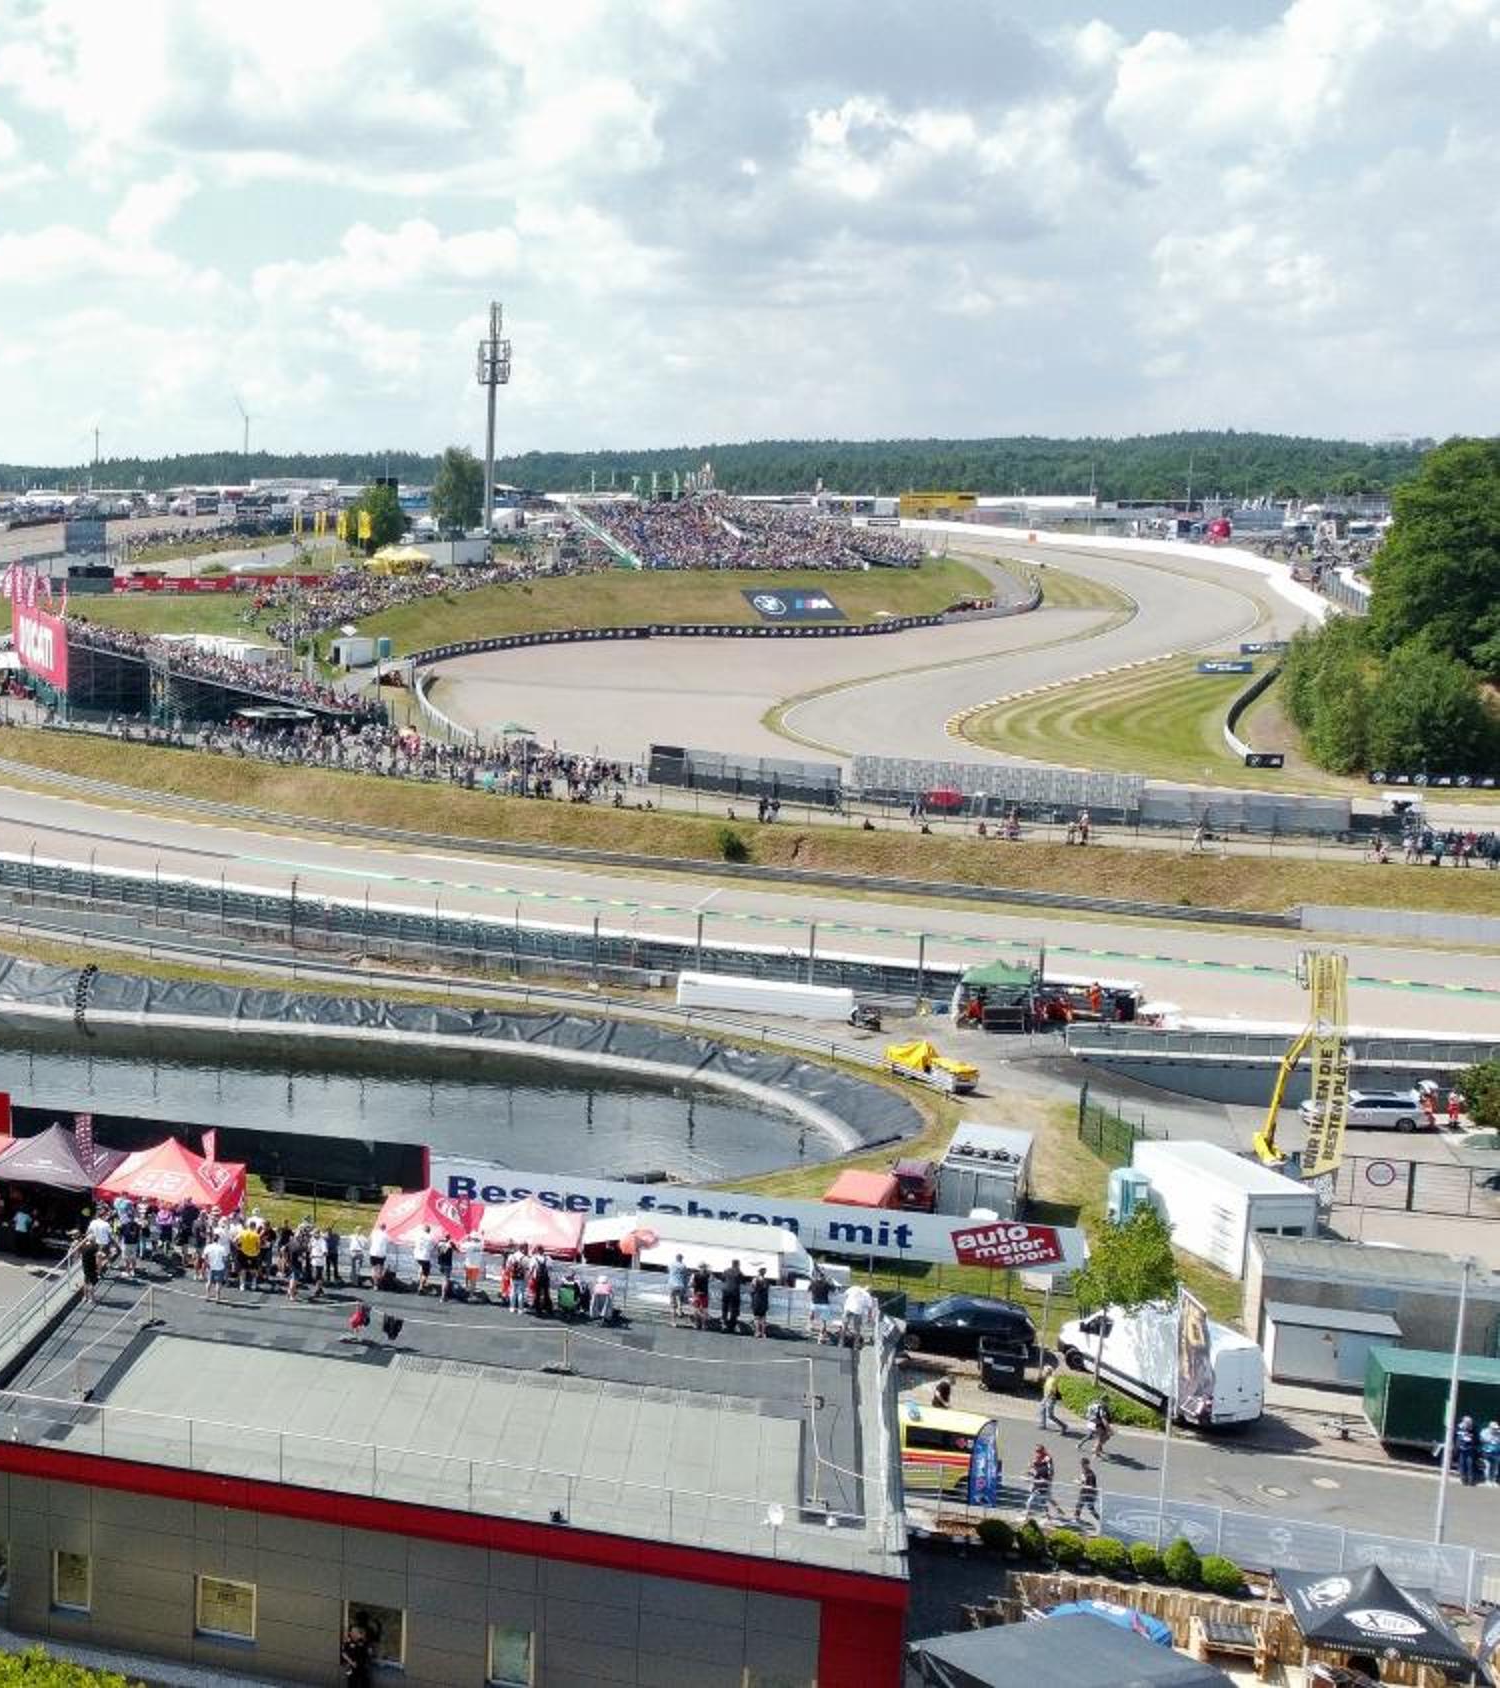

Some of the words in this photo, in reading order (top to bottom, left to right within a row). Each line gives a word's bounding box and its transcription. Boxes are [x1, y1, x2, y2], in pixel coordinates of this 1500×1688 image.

[1303, 1136, 1320, 1168] WIR
[1319, 1049, 1333, 1076] DIE
[1322, 1102, 1344, 1160] BESTEN
[448, 1175, 613, 1214] Besser
[828, 1219, 913, 1249] mit
[957, 1226, 1028, 1249] auto
[975, 1237, 1045, 1259] motor
[1003, 1247, 1056, 1265] sport
